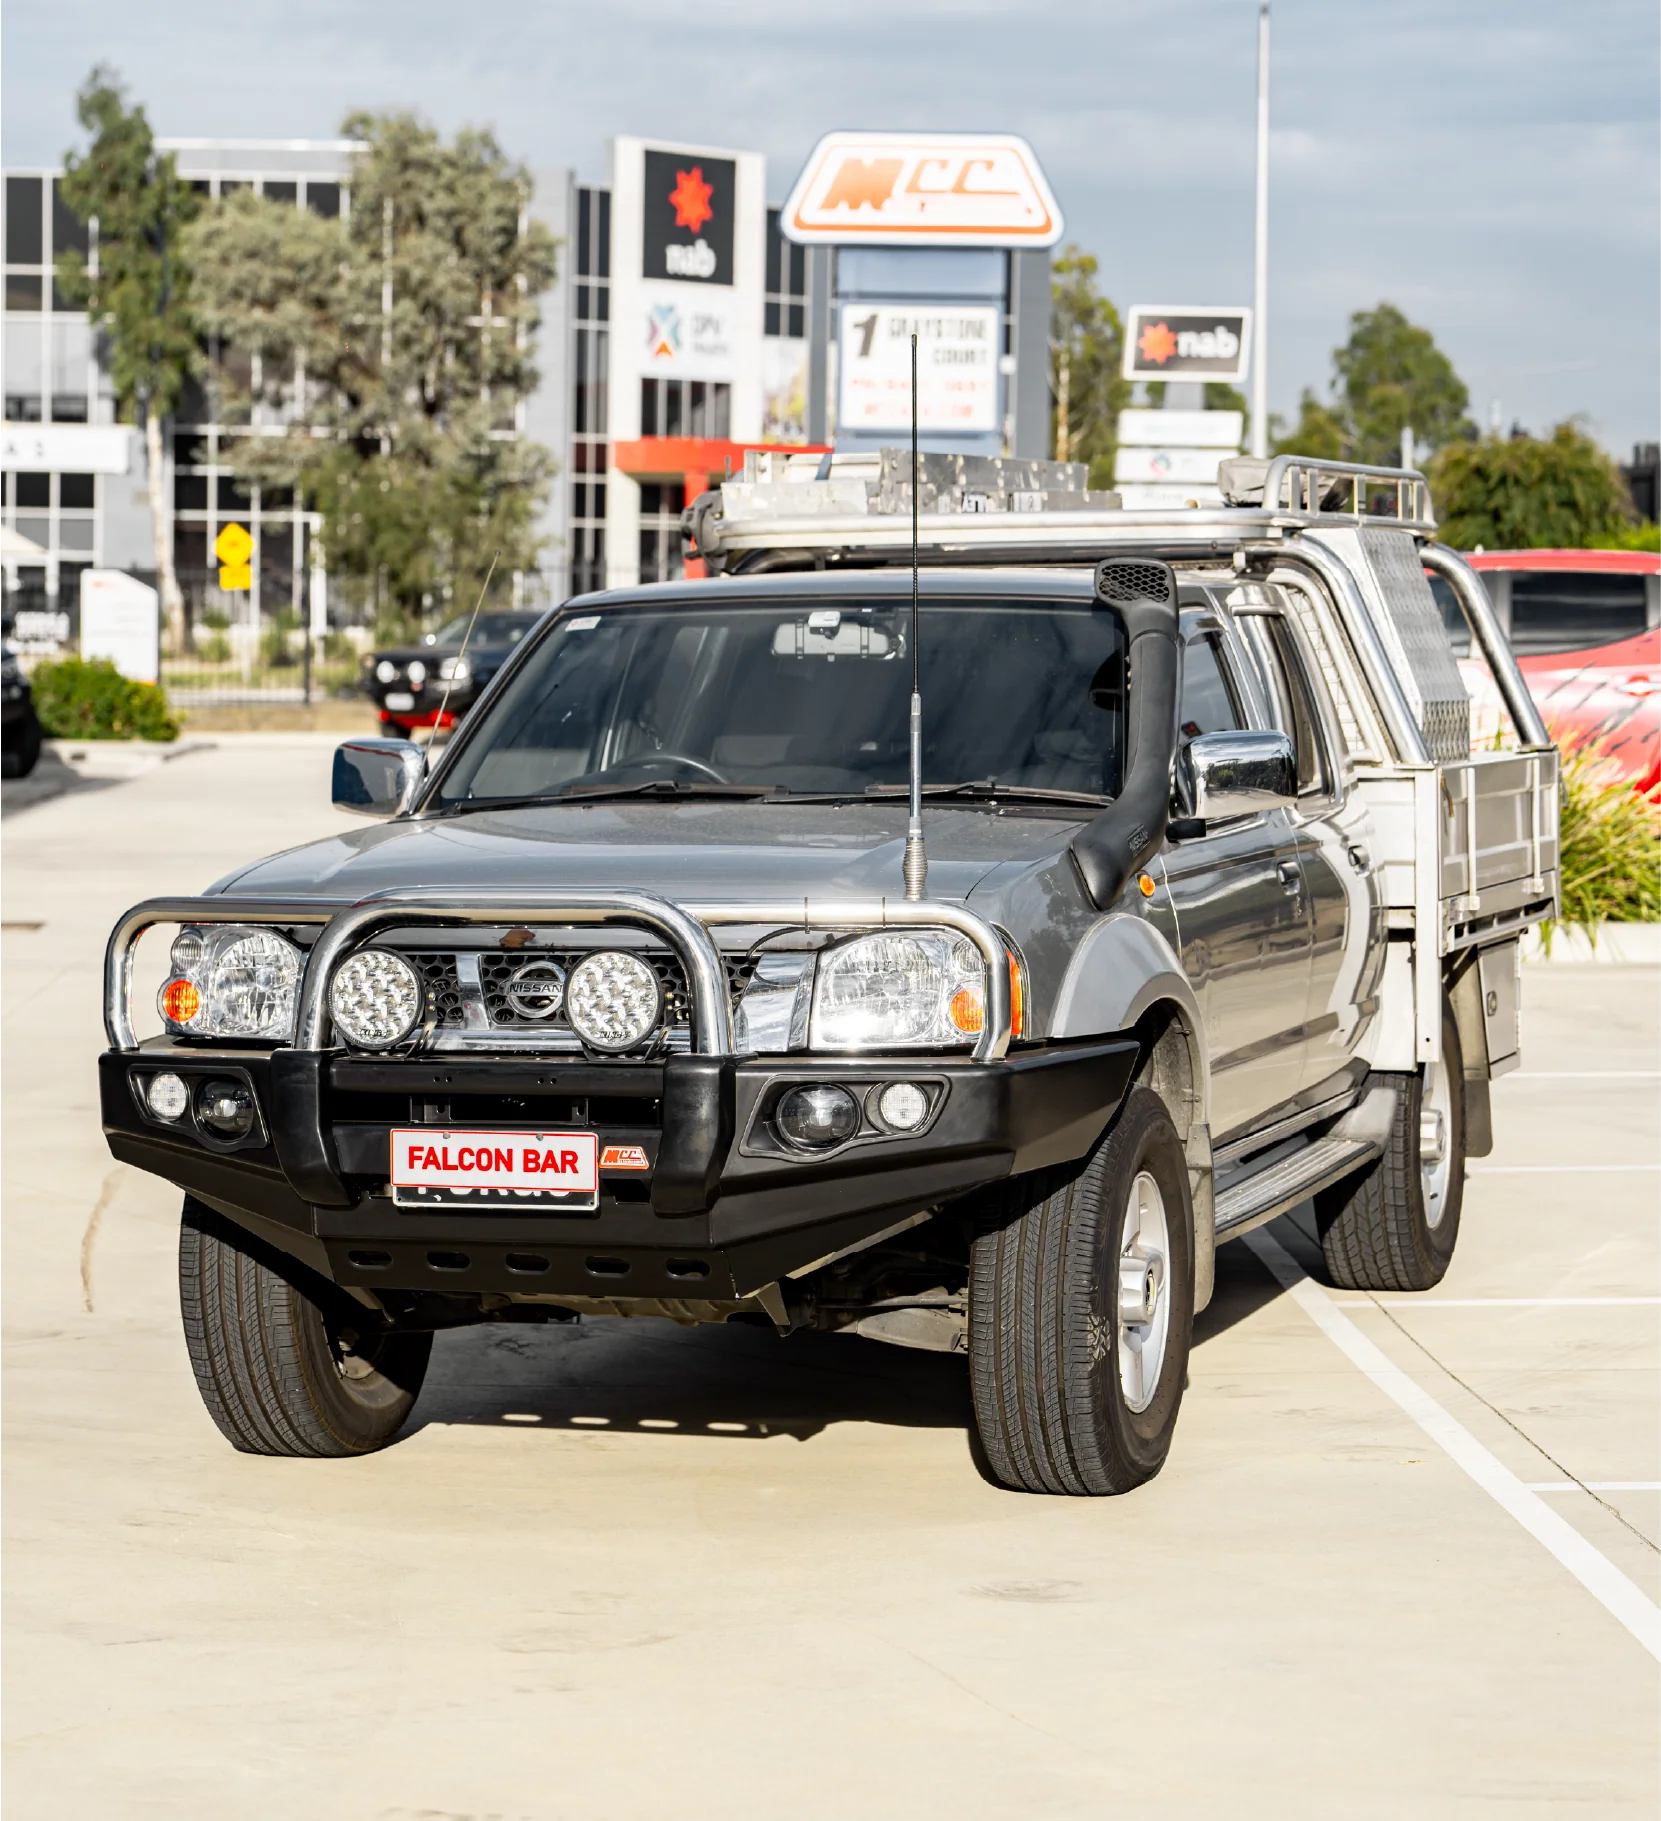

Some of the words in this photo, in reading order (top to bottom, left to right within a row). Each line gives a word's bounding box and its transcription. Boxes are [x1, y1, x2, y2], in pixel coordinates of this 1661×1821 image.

[665, 238, 717, 278] nab
[852, 312, 880, 359] 1
[1176, 325, 1240, 358] nab
[509, 983, 563, 993] NISSAN
[408, 1145, 514, 1172] FALCON
[522, 1148, 580, 1174] BAR
[603, 1149, 642, 1163] MCC
